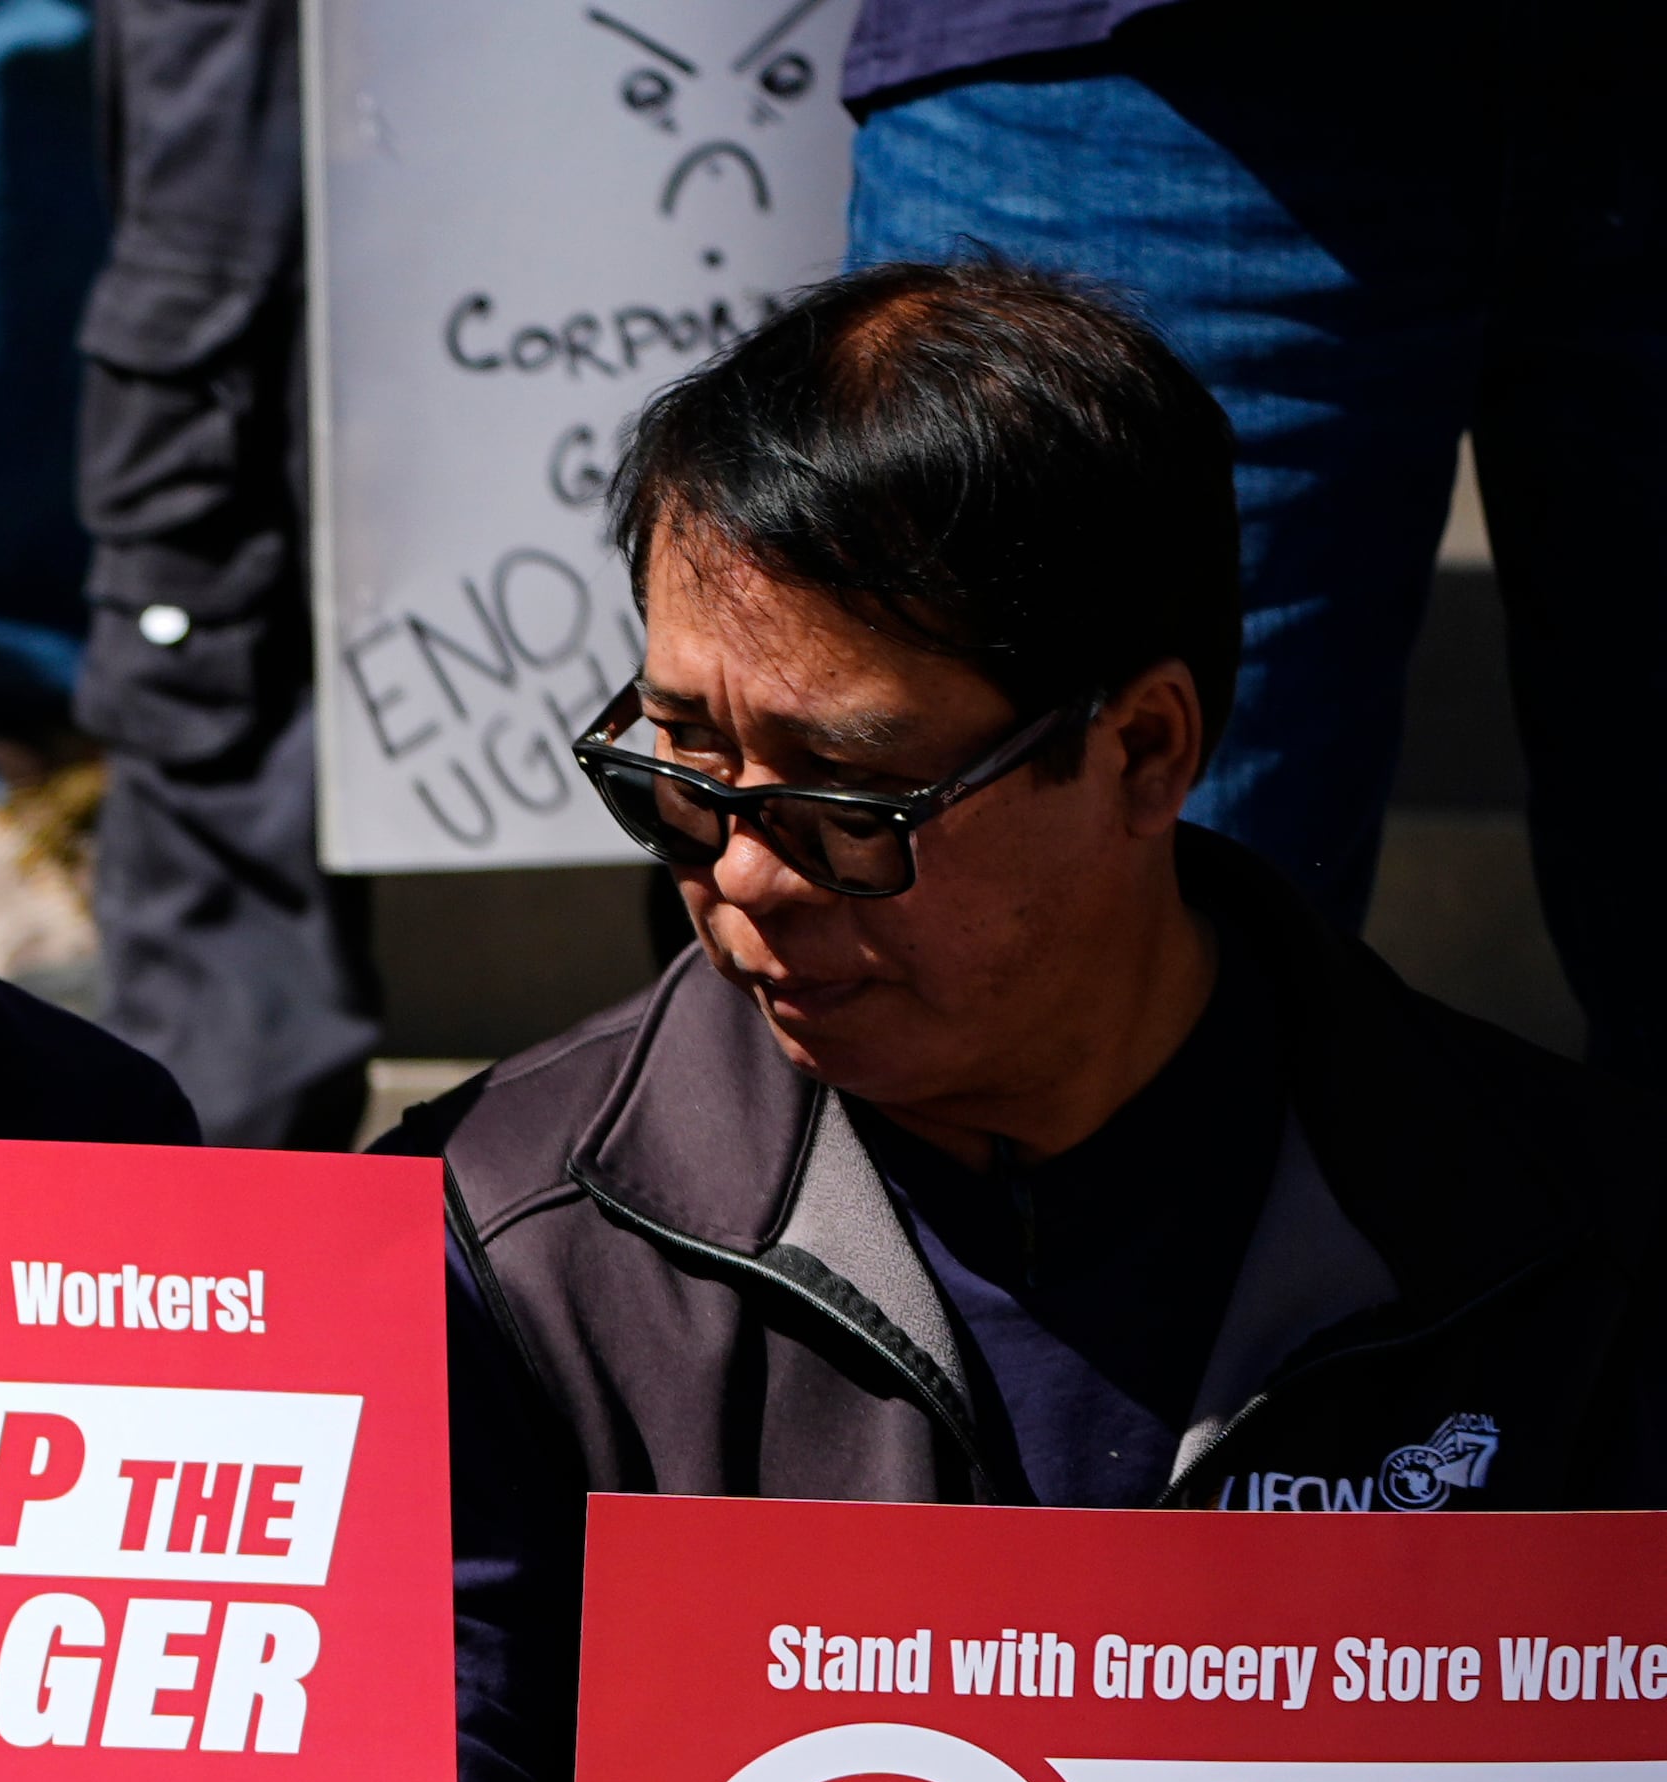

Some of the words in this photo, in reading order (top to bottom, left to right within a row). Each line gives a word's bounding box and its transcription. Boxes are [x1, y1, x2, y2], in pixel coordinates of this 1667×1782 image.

[10, 1260, 266, 1334] Workers!
[119, 1459, 304, 1557] THE
[767, 1624, 932, 1694] Stand
[949, 1628, 1076, 1698] with
[1093, 1633, 1318, 1710] Grocery
[1332, 1636, 1481, 1702] Store
